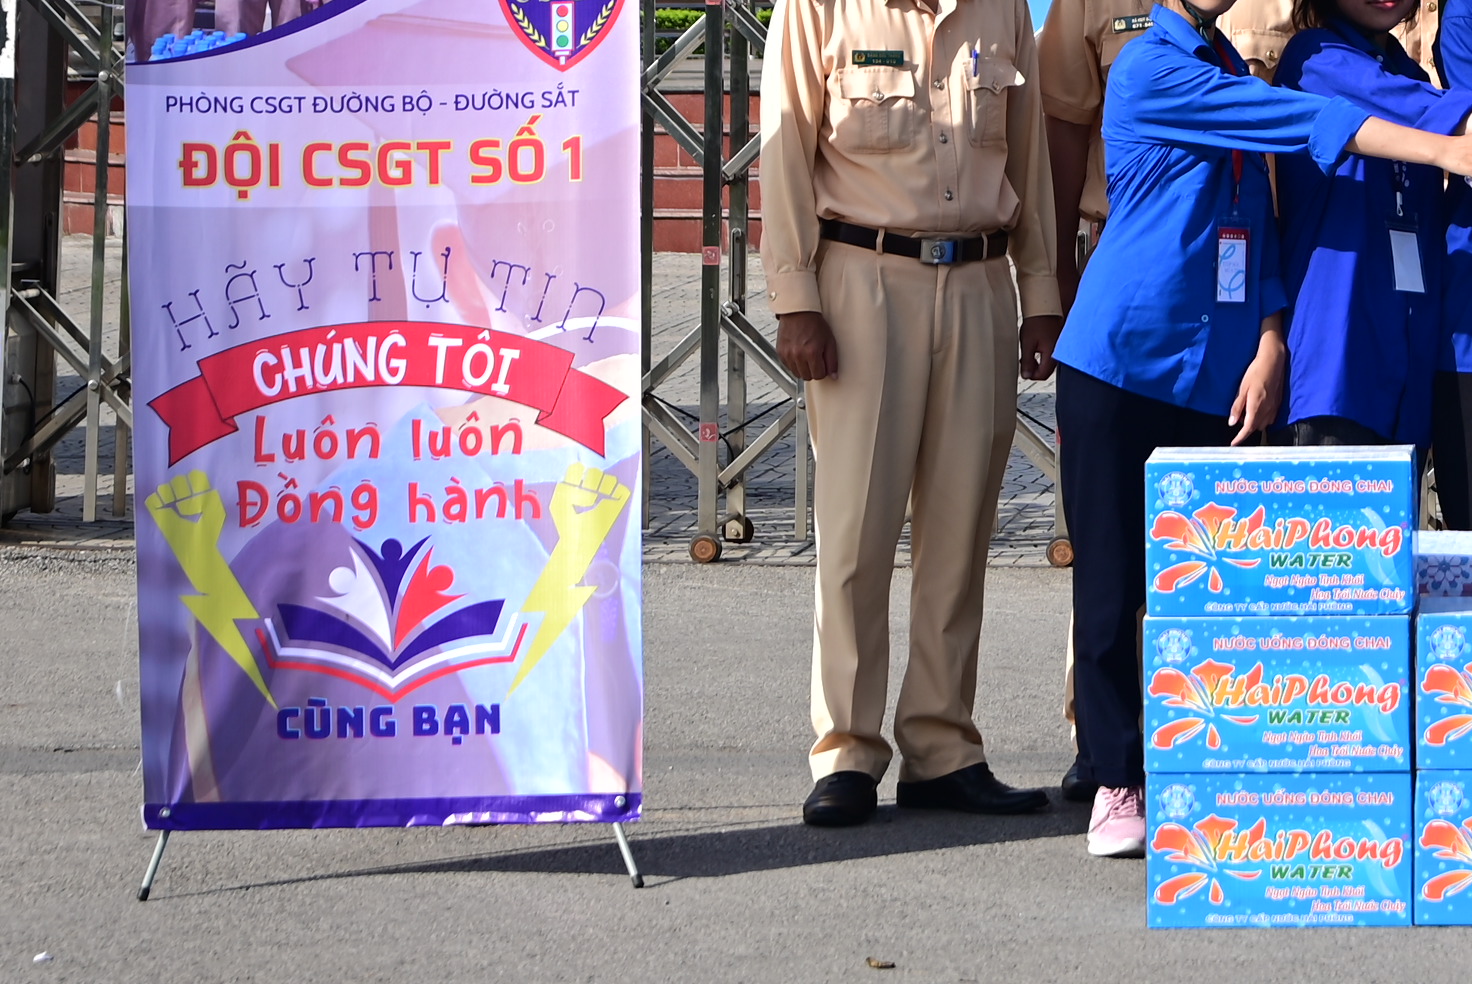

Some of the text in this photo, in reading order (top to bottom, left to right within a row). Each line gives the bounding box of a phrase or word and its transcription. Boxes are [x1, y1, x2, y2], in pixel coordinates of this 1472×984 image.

[166, 92, 244, 113] PHÒNG
[250, 96, 306, 113] CSGT
[312, 91, 395, 114] ĐƯỜNG
[402, 90, 433, 116] BỘ
[454, 88, 535, 111] ĐƯỜNG
[541, 82, 579, 109] SẮT
[178, 113, 583, 201] ĐỘI CSGT SỐ 1
[161, 256, 316, 352] HÃY
[353, 247, 452, 309] TỰ
[252, 329, 521, 397] CHÚNG TÔI
[254, 411, 524, 464] Luôn luôn
[236, 472, 543, 530] Đồng hành
[1215, 476, 1393, 494] NƯỚC UỐNG ĐÓNG CHAI
[1215, 518, 1402, 556] HaiPhong
[1269, 552, 1353, 568] WATER
[1213, 633, 1391, 650] NƯỚC UỐNG ĐÓNG CHAI
[1213, 675, 1400, 713] HaiPhong
[412, 703, 501, 746] BẠN
[1267, 709, 1351, 725] WATER
[1216, 788, 1394, 806] NƯỚC UỐNG ĐÓNG CHAI
[1216, 830, 1403, 868] HaiPhong
[1270, 864, 1353, 880] WATER
